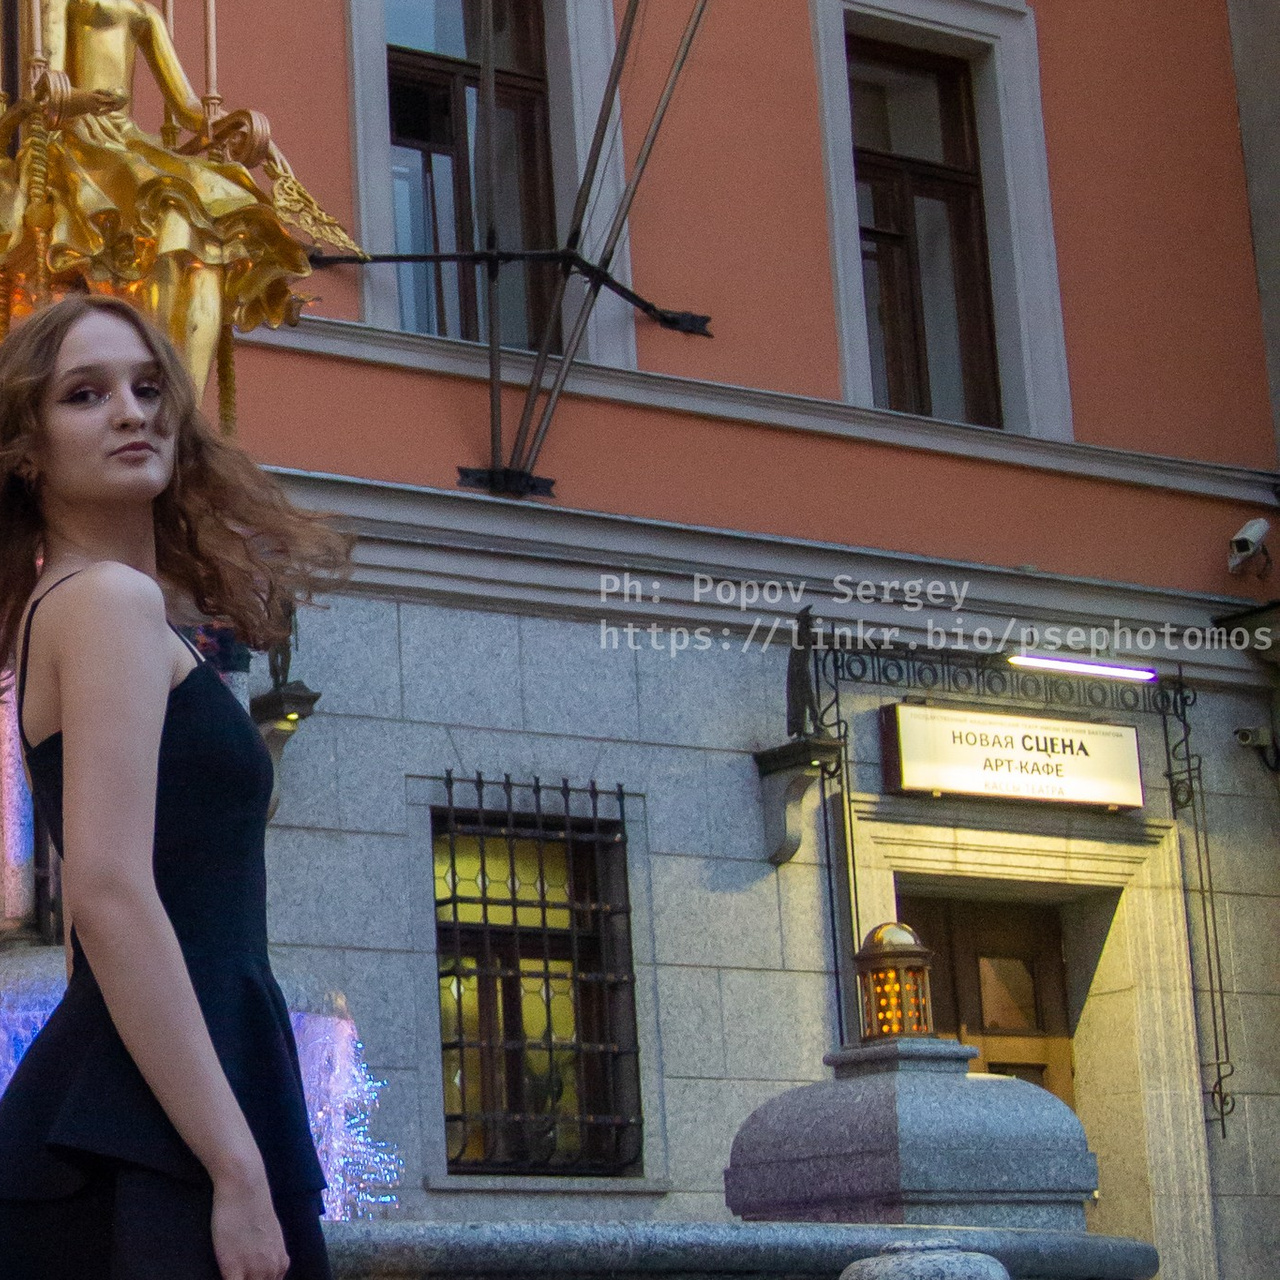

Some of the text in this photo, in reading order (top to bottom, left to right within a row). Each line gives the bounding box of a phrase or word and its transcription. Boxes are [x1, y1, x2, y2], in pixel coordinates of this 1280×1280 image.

[951, 730, 1090, 758] НОВАЯ СЦЕНА
[983, 757, 1064, 778] АРТ-КАФЕ
[1025, 783, 1065, 796] ТЕАТРА
